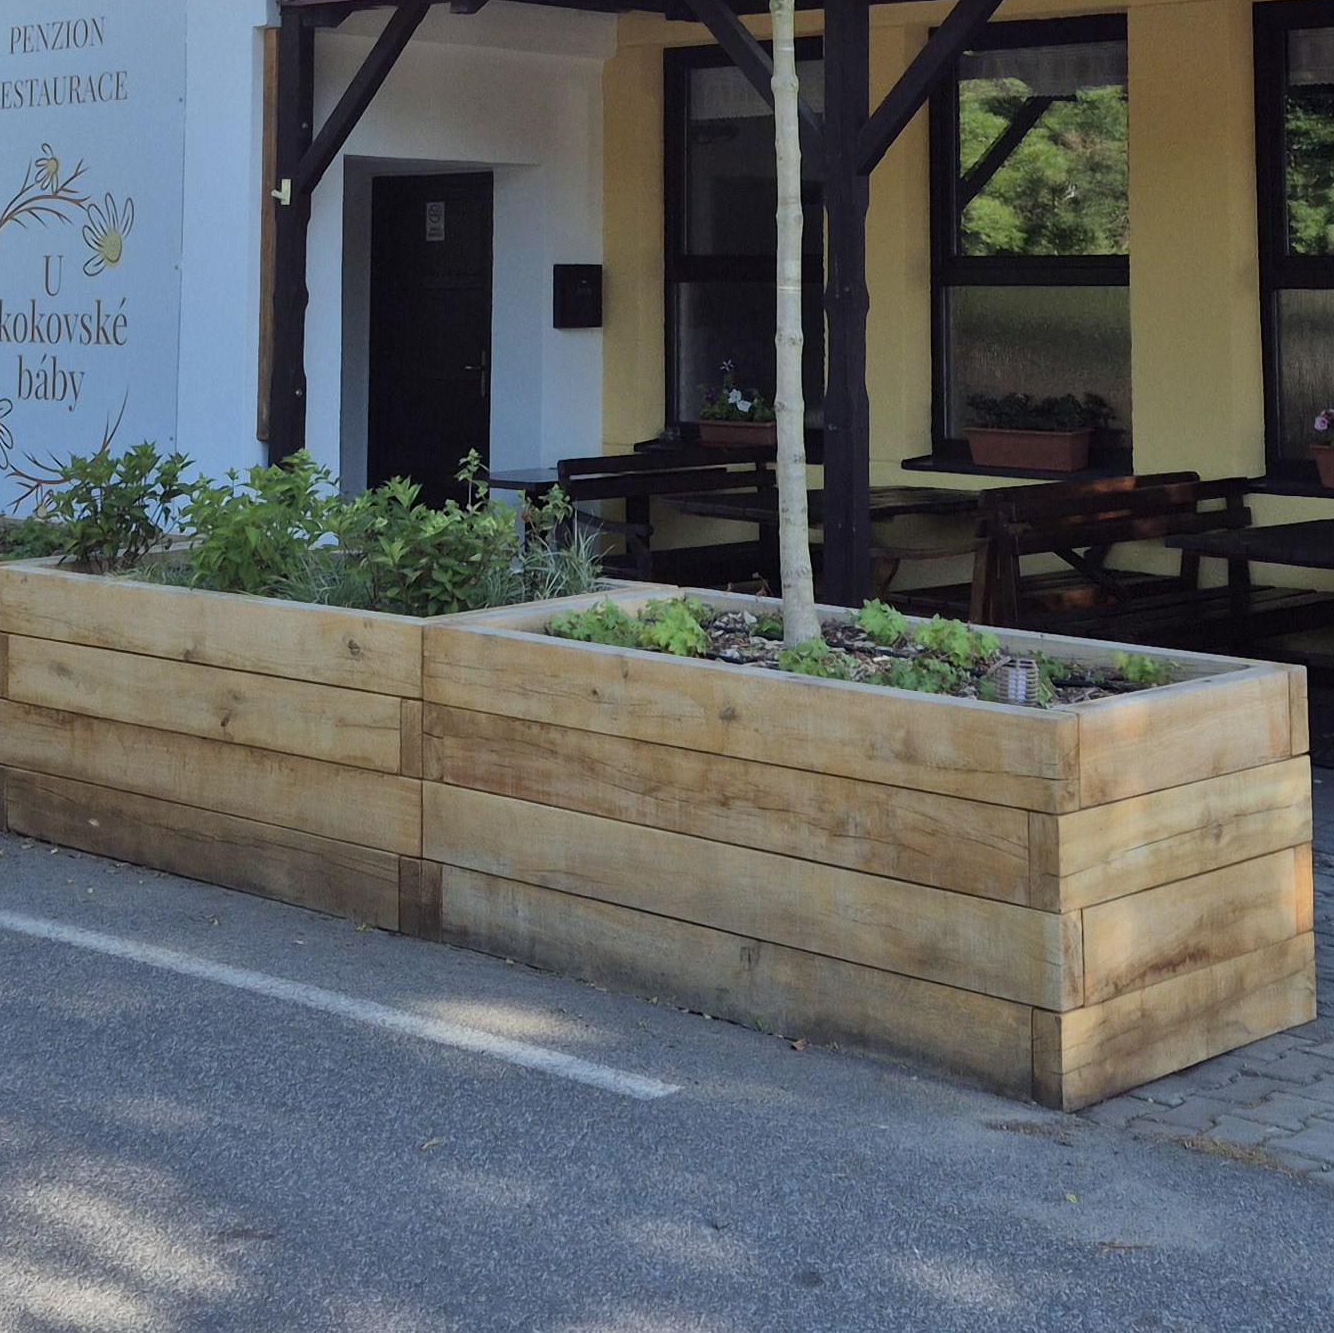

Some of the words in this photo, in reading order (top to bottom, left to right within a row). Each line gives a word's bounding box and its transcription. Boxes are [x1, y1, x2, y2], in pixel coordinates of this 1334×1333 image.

[9, 16, 105, 55] PENZION
[43, 254, 64, 297] U
[17, 354, 86, 413] báby
